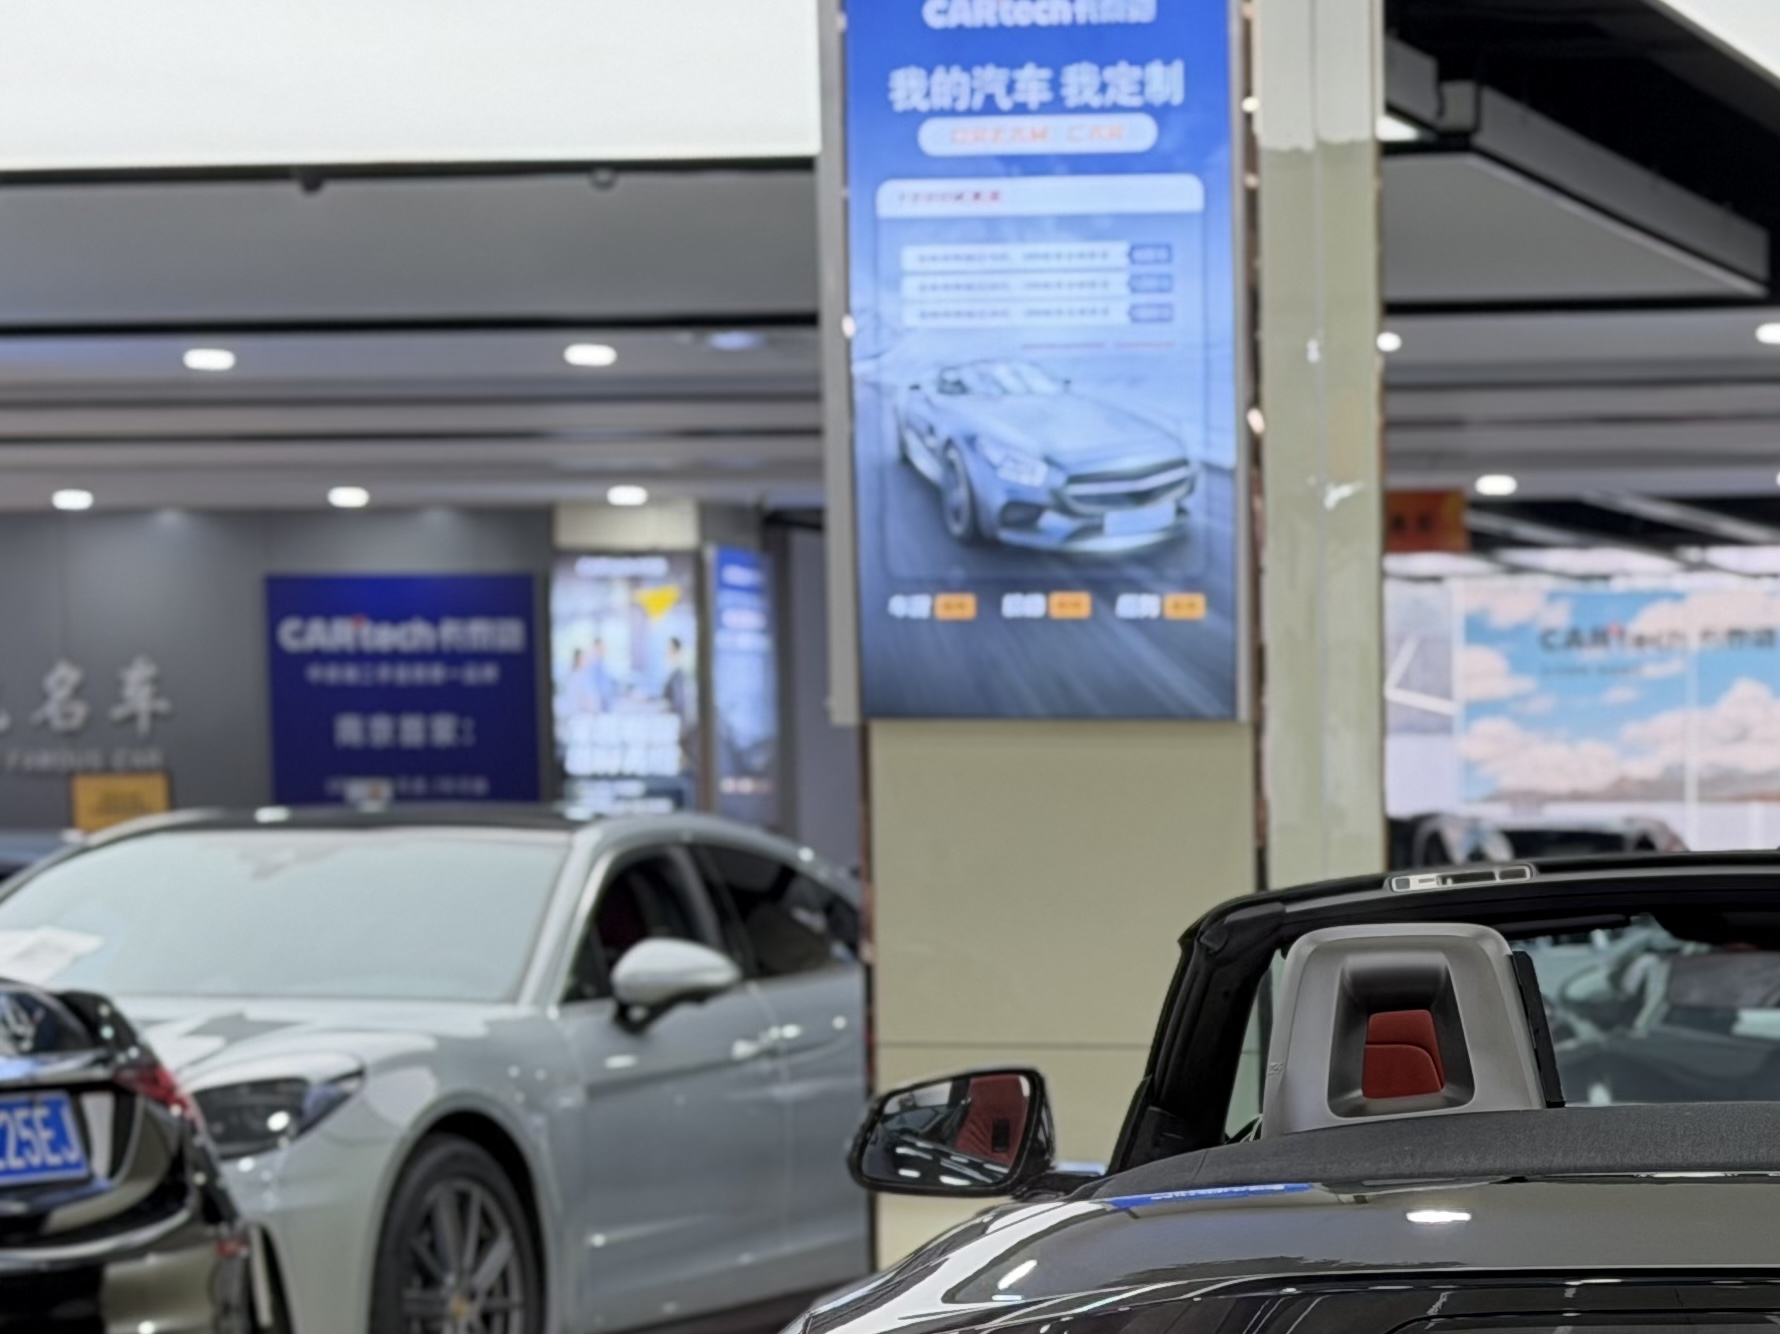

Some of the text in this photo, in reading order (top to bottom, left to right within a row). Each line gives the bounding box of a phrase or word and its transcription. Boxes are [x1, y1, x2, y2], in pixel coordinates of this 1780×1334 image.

[888, 58, 1185, 112] 我的汽车 我定制
[0, 655, 173, 738] 名车
[0, 1108, 81, 1169] 25EJ
